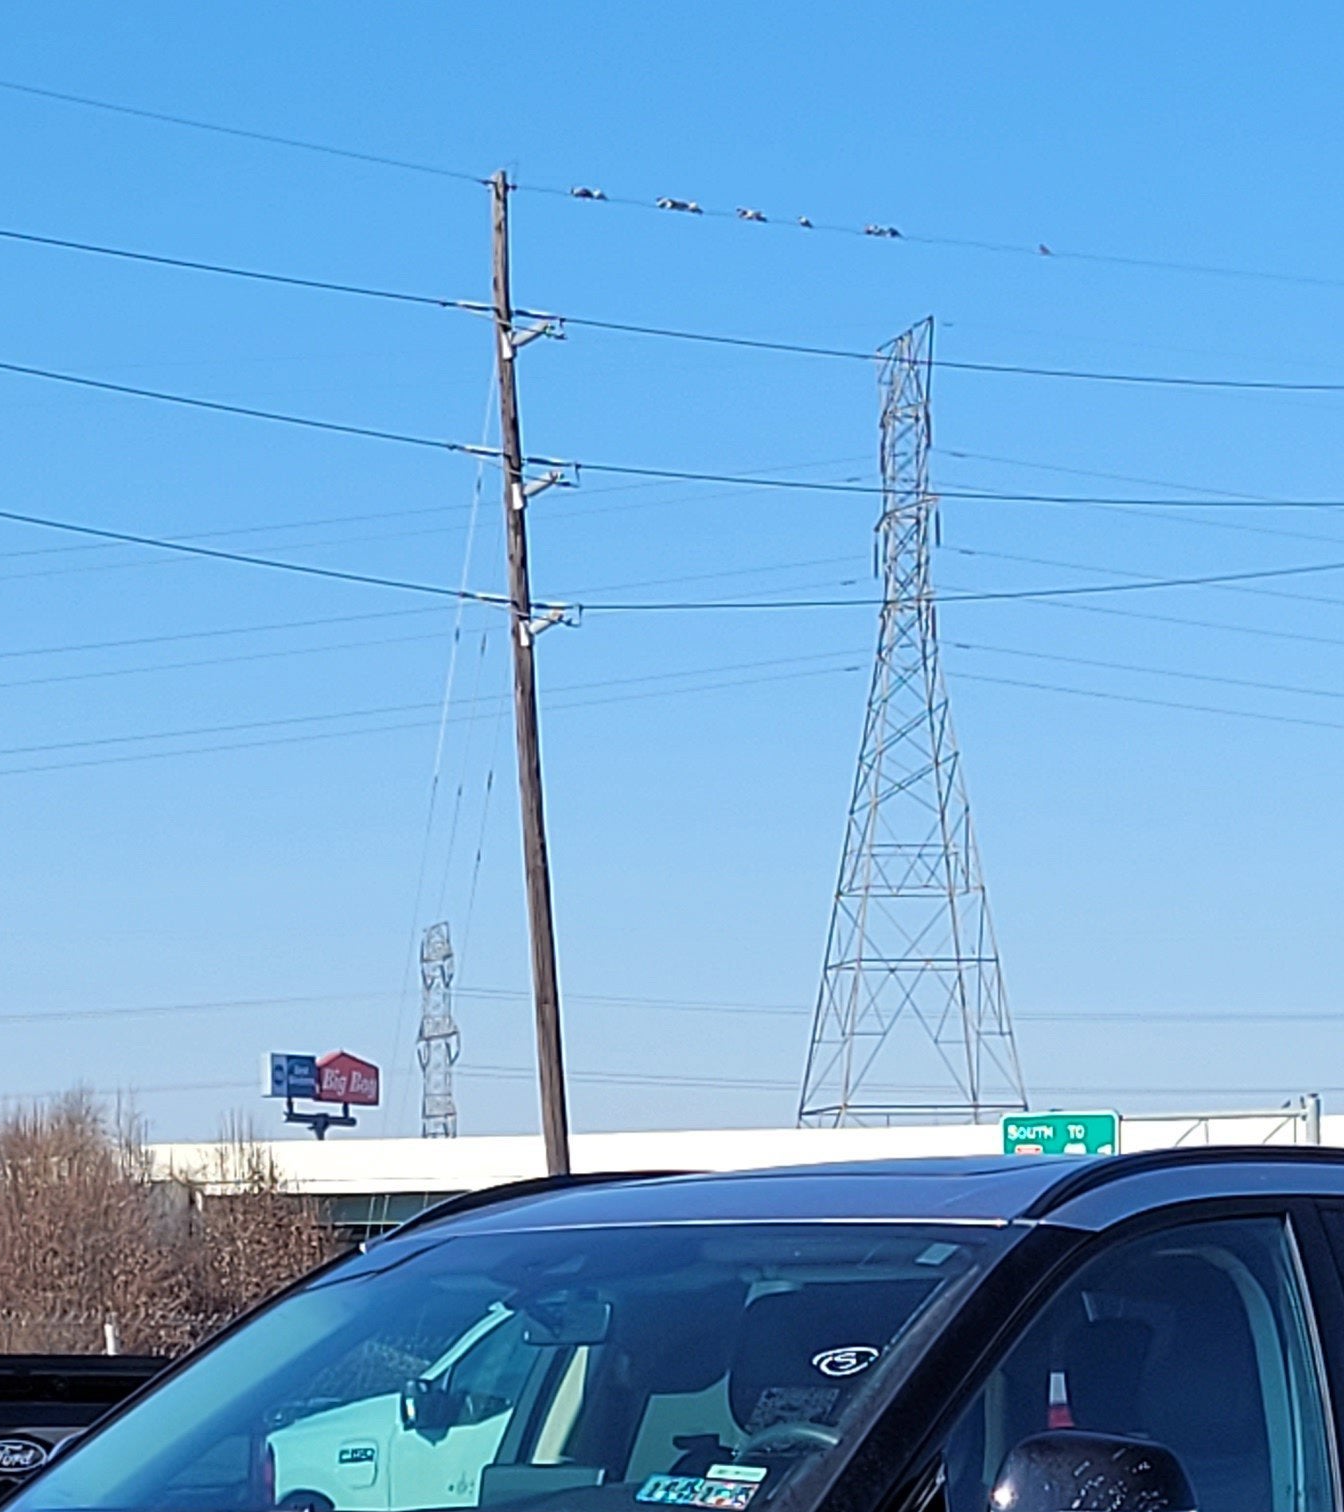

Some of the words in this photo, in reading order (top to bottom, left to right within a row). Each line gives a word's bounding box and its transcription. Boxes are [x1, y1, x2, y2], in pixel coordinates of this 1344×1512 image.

[322, 1069, 347, 1096] Big
[349, 1070, 377, 1099] Boy
[1007, 1124, 1054, 1140] SOUTH
[1067, 1124, 1085, 1139] TO
